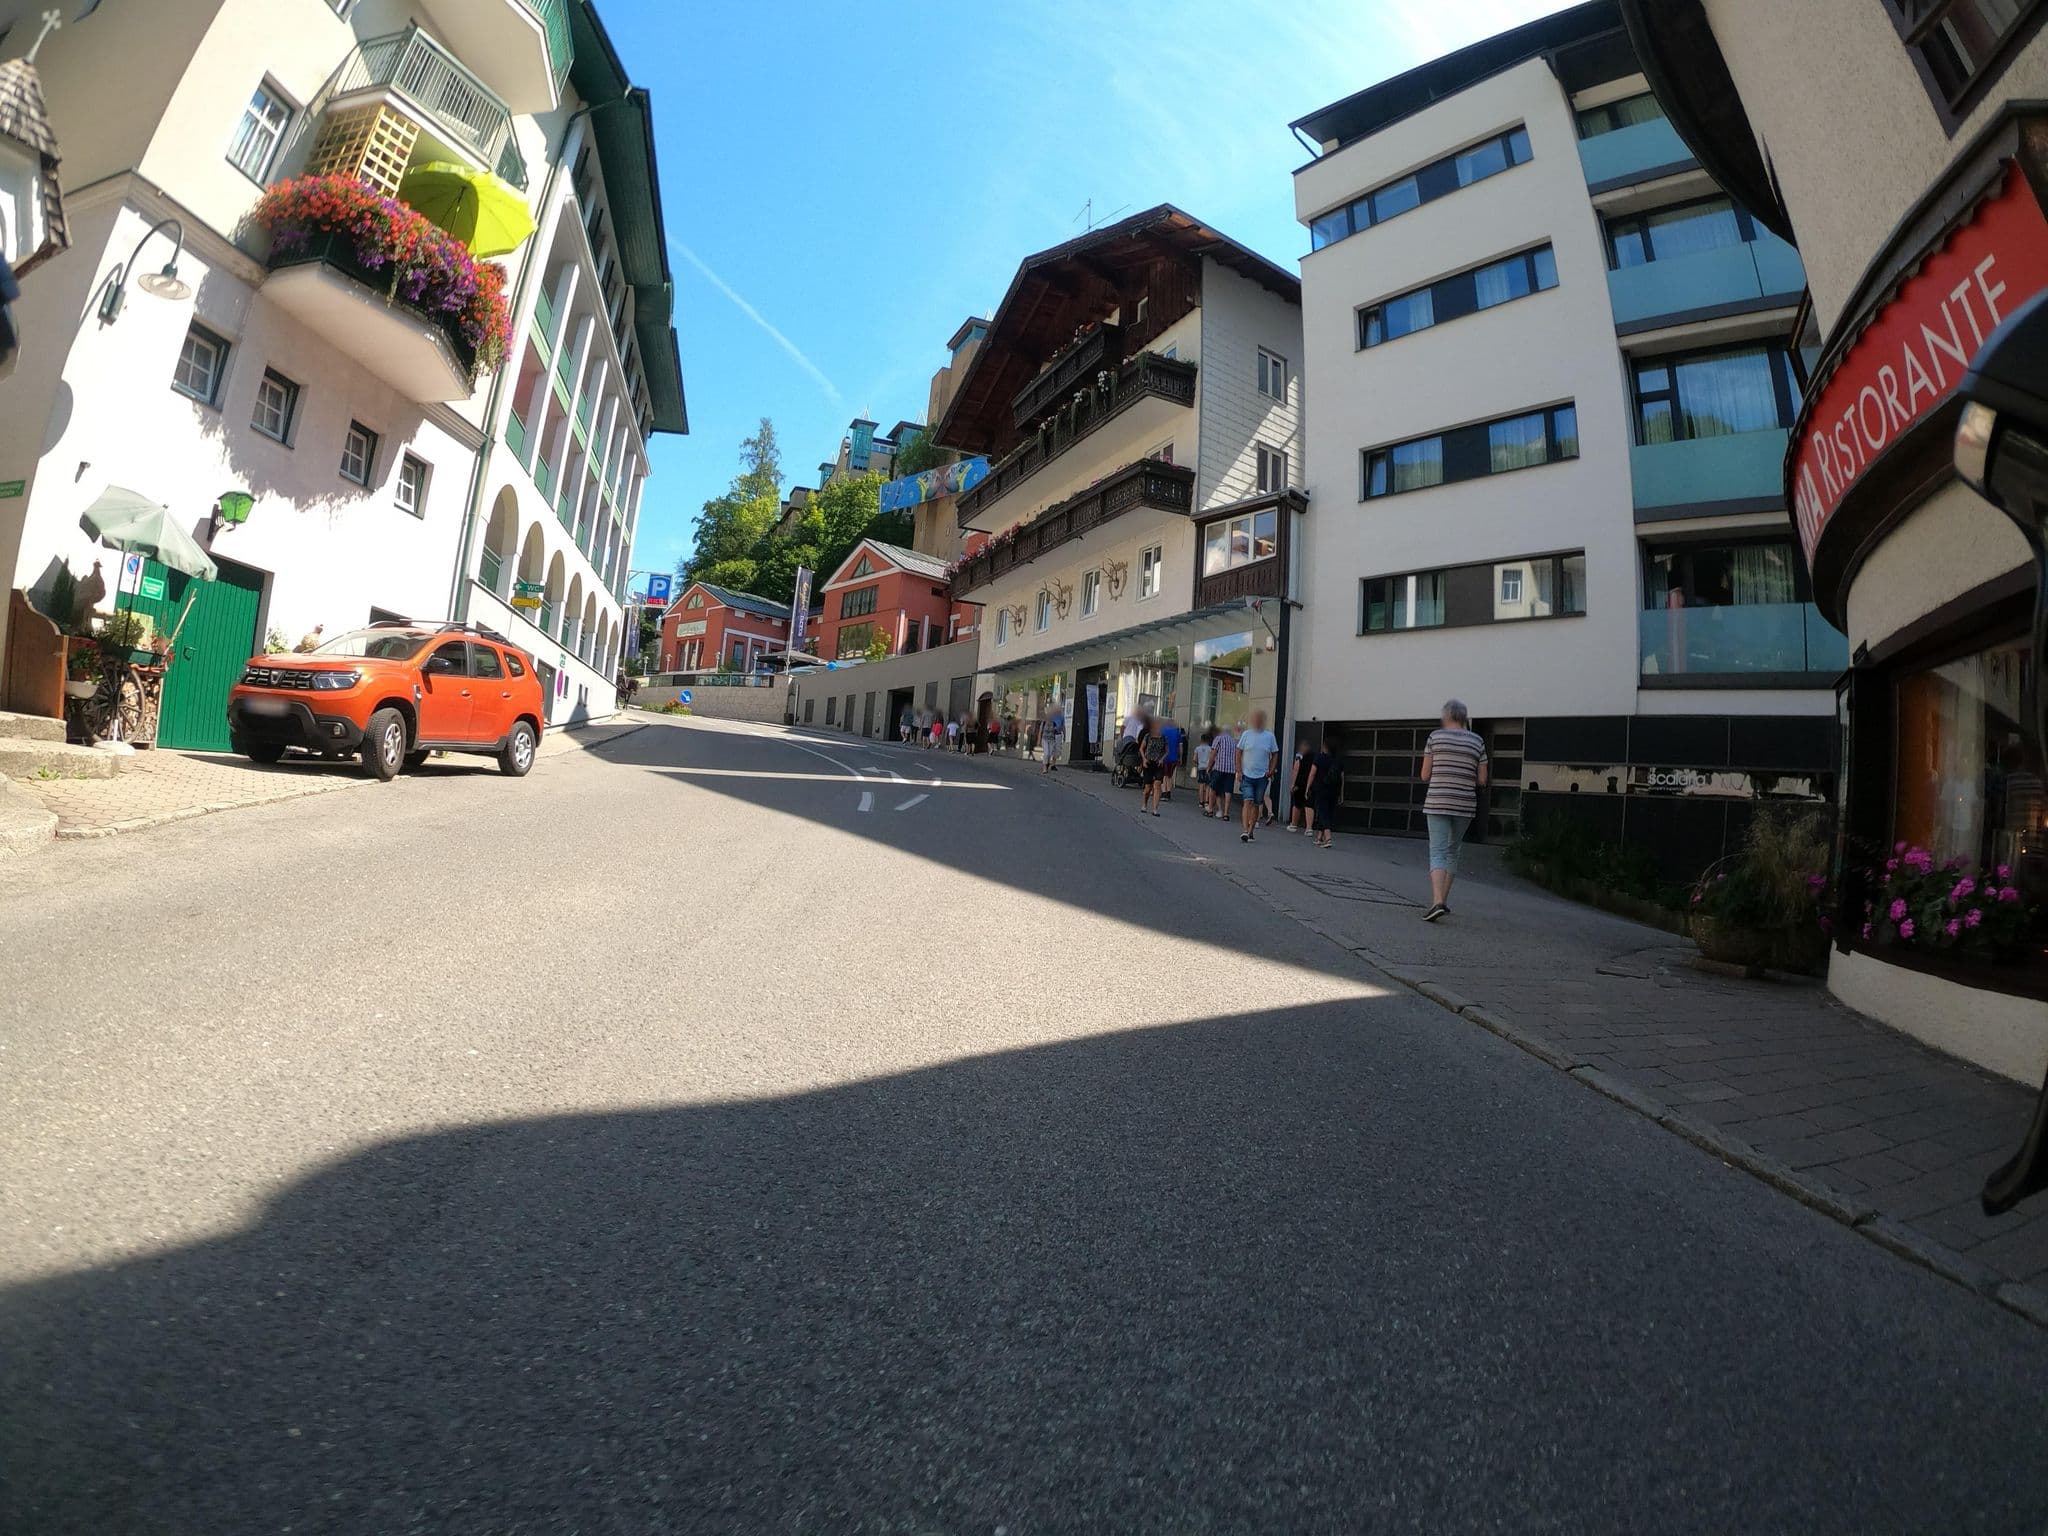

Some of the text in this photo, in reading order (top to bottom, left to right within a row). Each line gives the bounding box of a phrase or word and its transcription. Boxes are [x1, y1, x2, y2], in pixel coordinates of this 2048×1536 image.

[1813, 254, 2006, 504] RISTORANTE
[527, 584, 540, 592] WC
[651, 579, 666, 596] P
